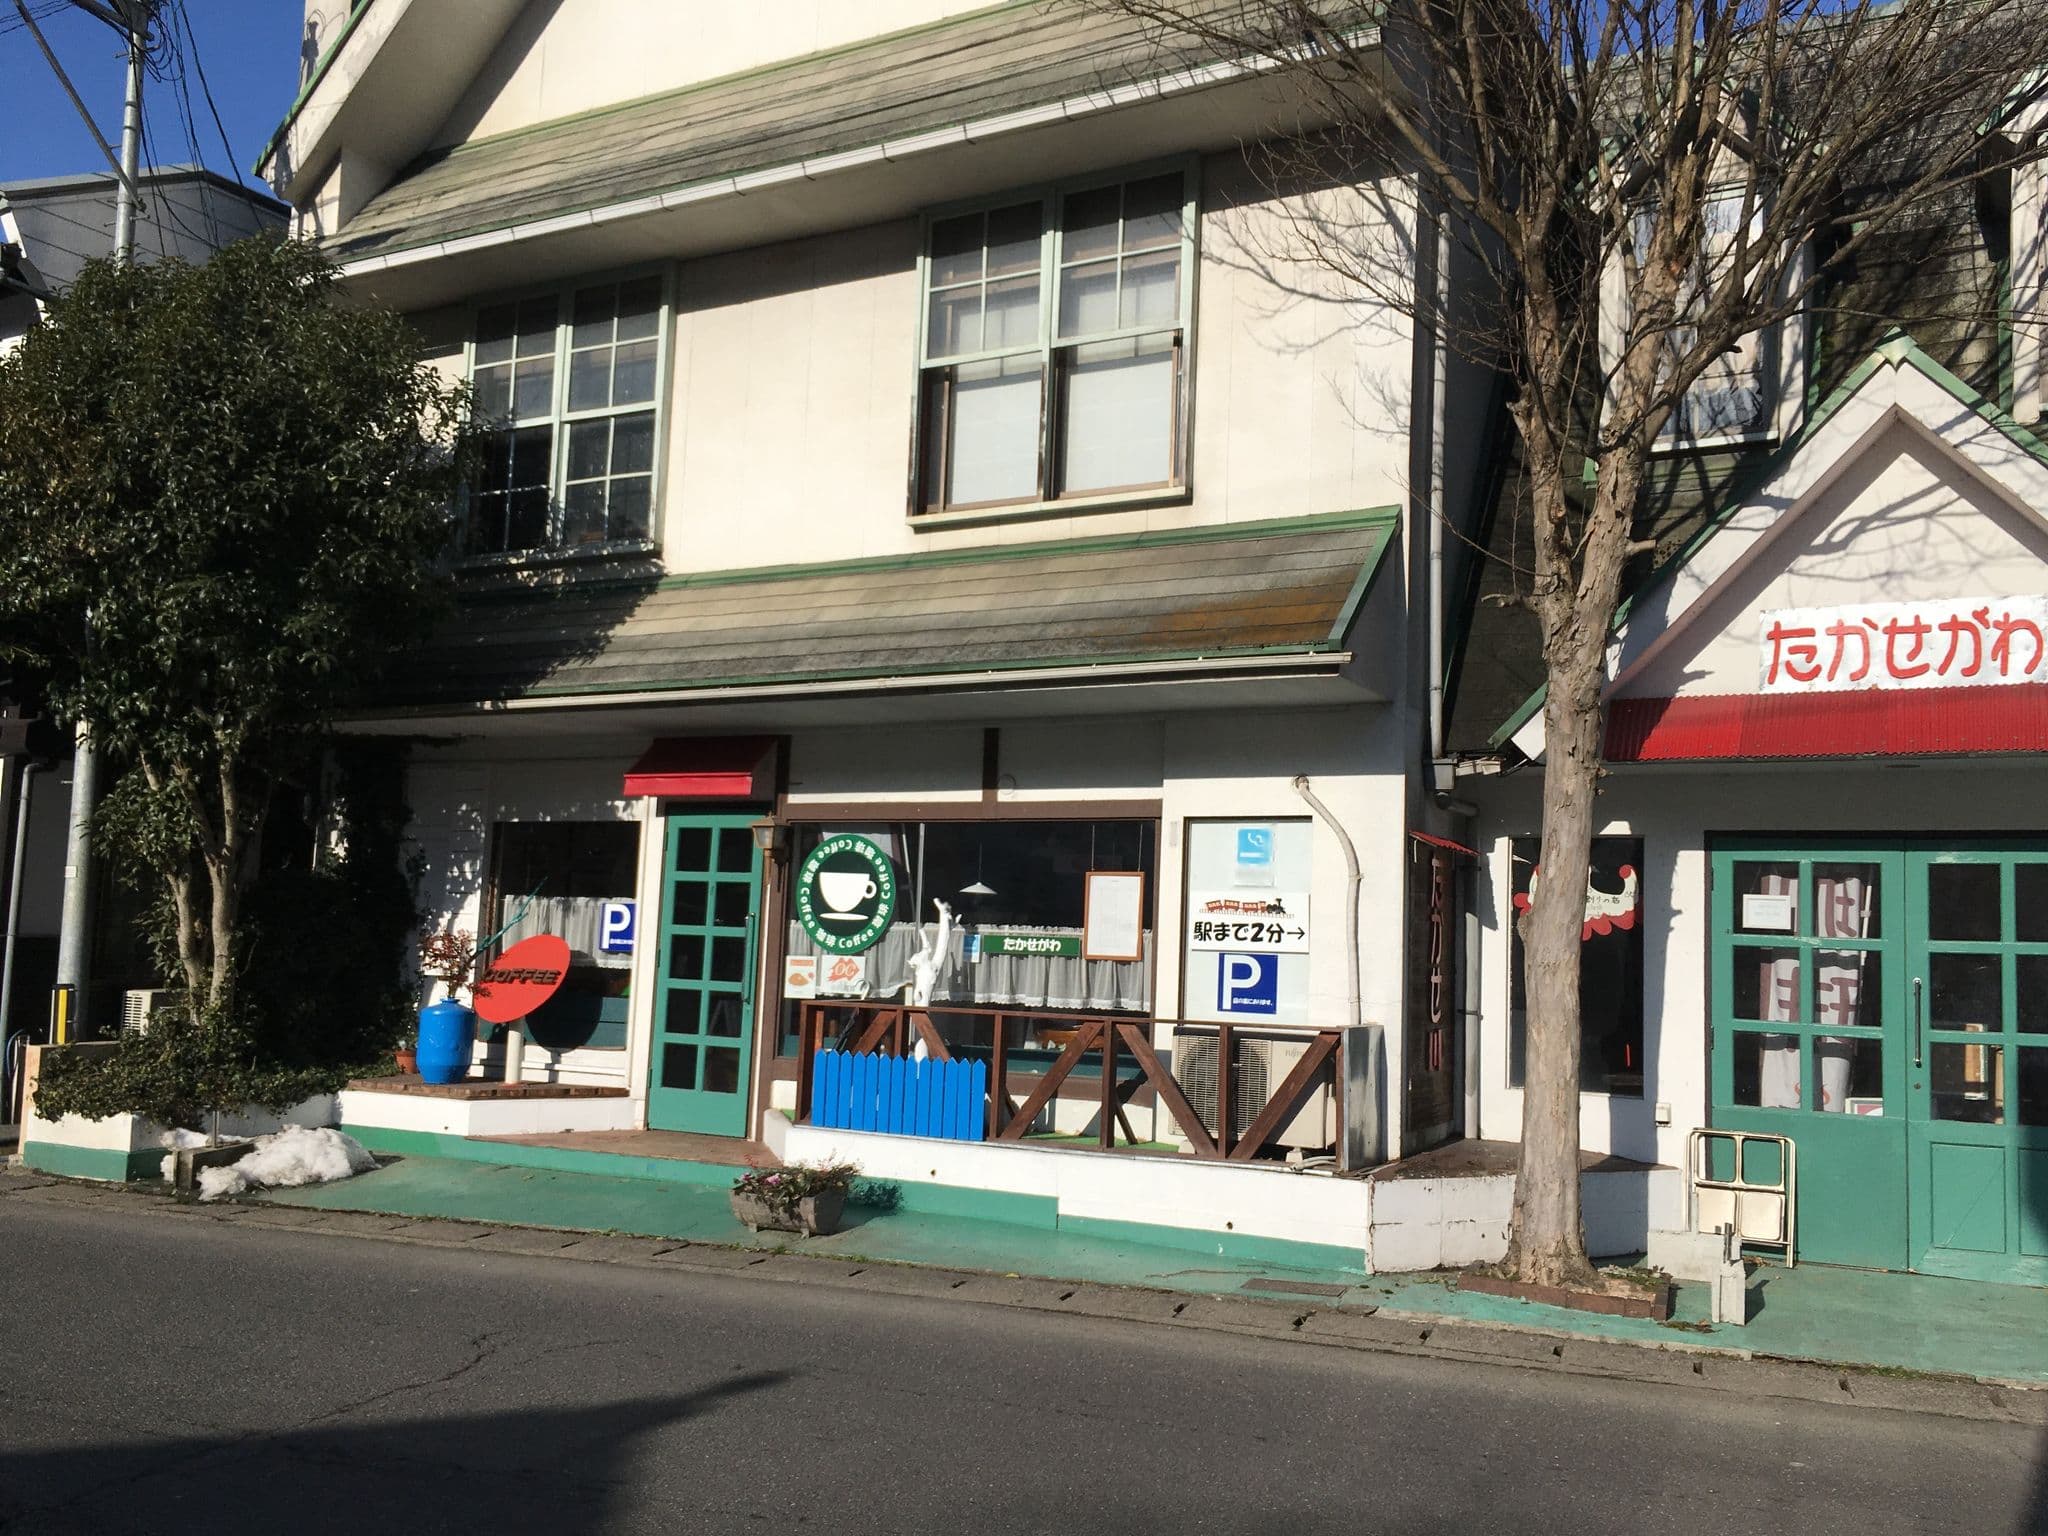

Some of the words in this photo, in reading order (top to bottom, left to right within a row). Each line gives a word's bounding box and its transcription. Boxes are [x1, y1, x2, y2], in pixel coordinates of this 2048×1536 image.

[1766, 606, 2044, 685] たかせがわ
[602, 903, 631, 949] P
[1193, 921, 1285, 944] 駅まで2分
[839, 929, 875, 948] Coffee
[1003, 937, 1062, 952] たかせがわ
[483, 967, 561, 986] COFFEE
[1222, 955, 1262, 1010] P
